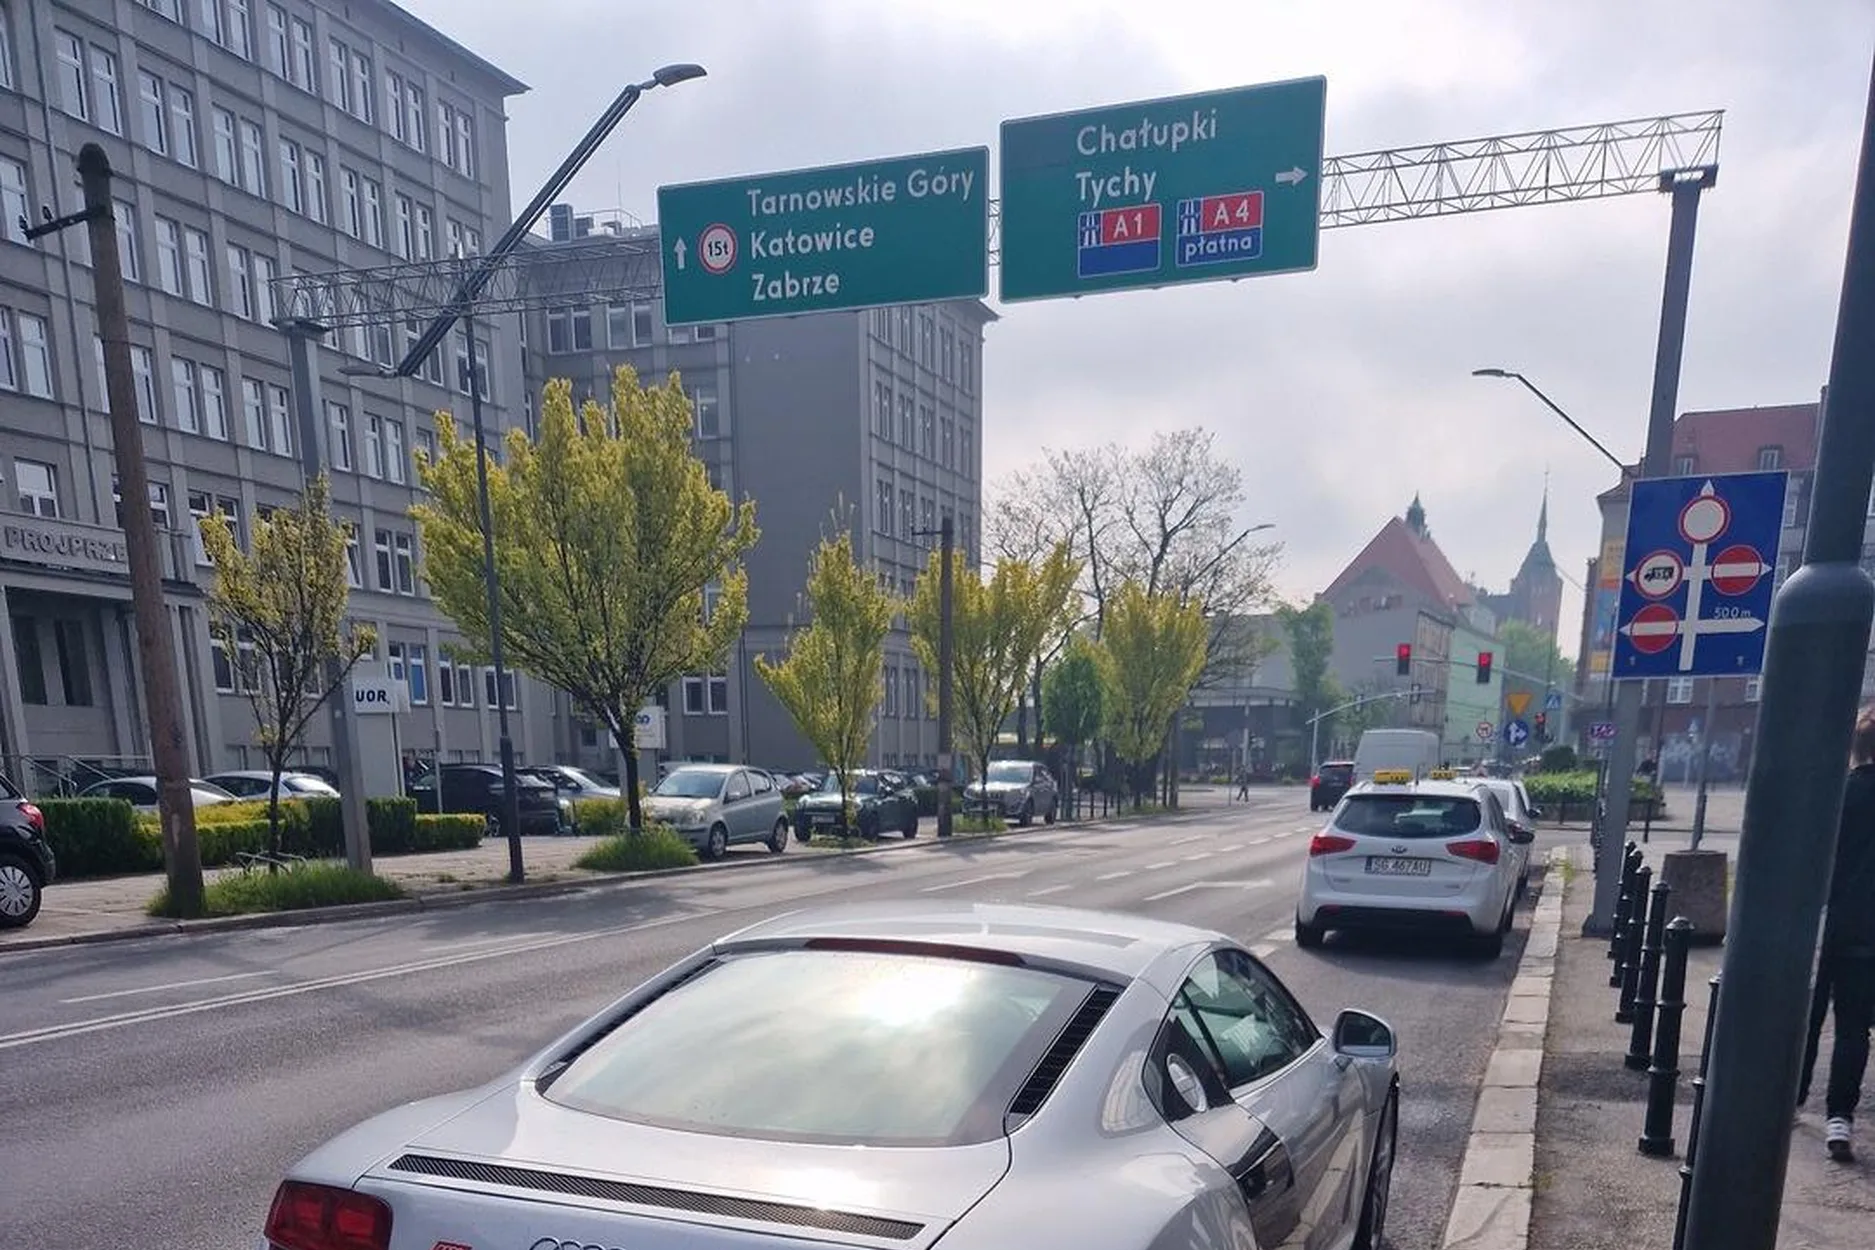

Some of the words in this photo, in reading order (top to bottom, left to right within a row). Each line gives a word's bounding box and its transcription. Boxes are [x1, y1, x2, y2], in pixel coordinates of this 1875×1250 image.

[1077, 108, 1217, 155] Chałupki
[748, 177, 896, 216] Tarnowskie
[907, 166, 974, 201] Góry
[1075, 166, 1156, 208] Tychy
[708, 241, 729, 257] 15t
[751, 223, 874, 259] Katowice
[1185, 235, 1252, 261] płatna
[752, 271, 840, 301] Zabrze
[5, 526, 126, 562] PROJPRZE
